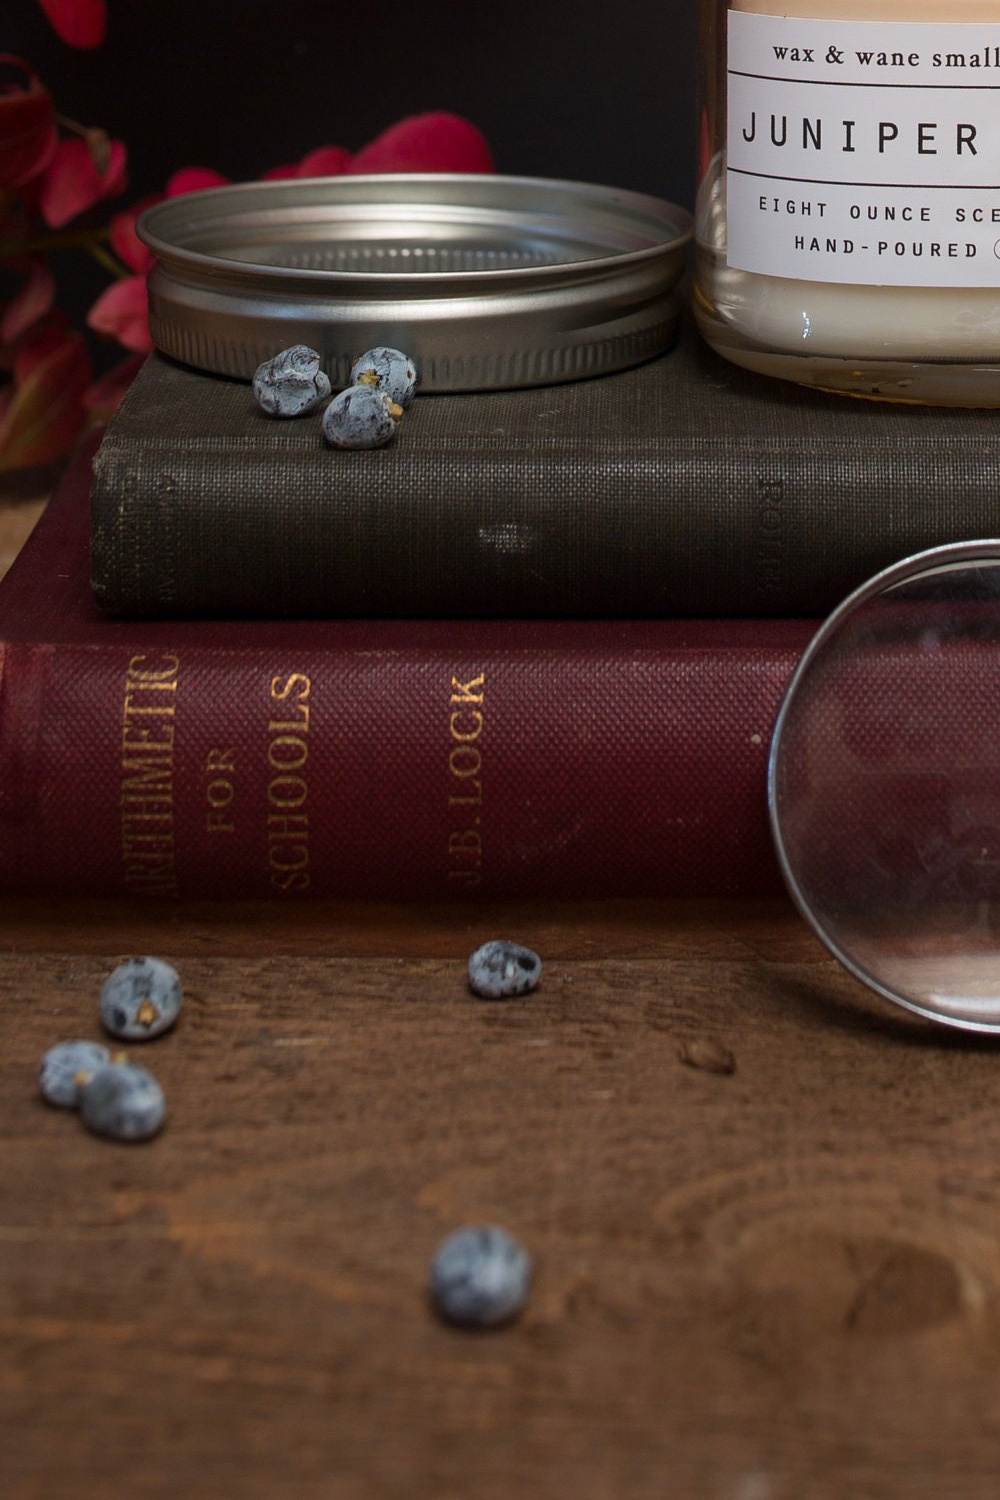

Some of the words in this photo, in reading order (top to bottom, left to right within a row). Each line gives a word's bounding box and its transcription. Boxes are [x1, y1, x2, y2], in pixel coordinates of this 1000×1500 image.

[772, 45, 815, 62] wax
[825, 45, 845, 64] &
[855, 50, 920, 67] wane
[932, 46, 1000, 68] small
[742, 112, 978, 156] JUNIPER
[759, 196, 827, 218] EIGHT
[850, 205, 931, 222] OUNCE
[795, 235, 977, 258] HAND-POURED
[449, 672, 486, 805] LOCK
[122, 654, 180, 899] ARITHMETIC
[206, 748, 236, 833] FOR
[267, 671, 311, 890] SCHOOLS
